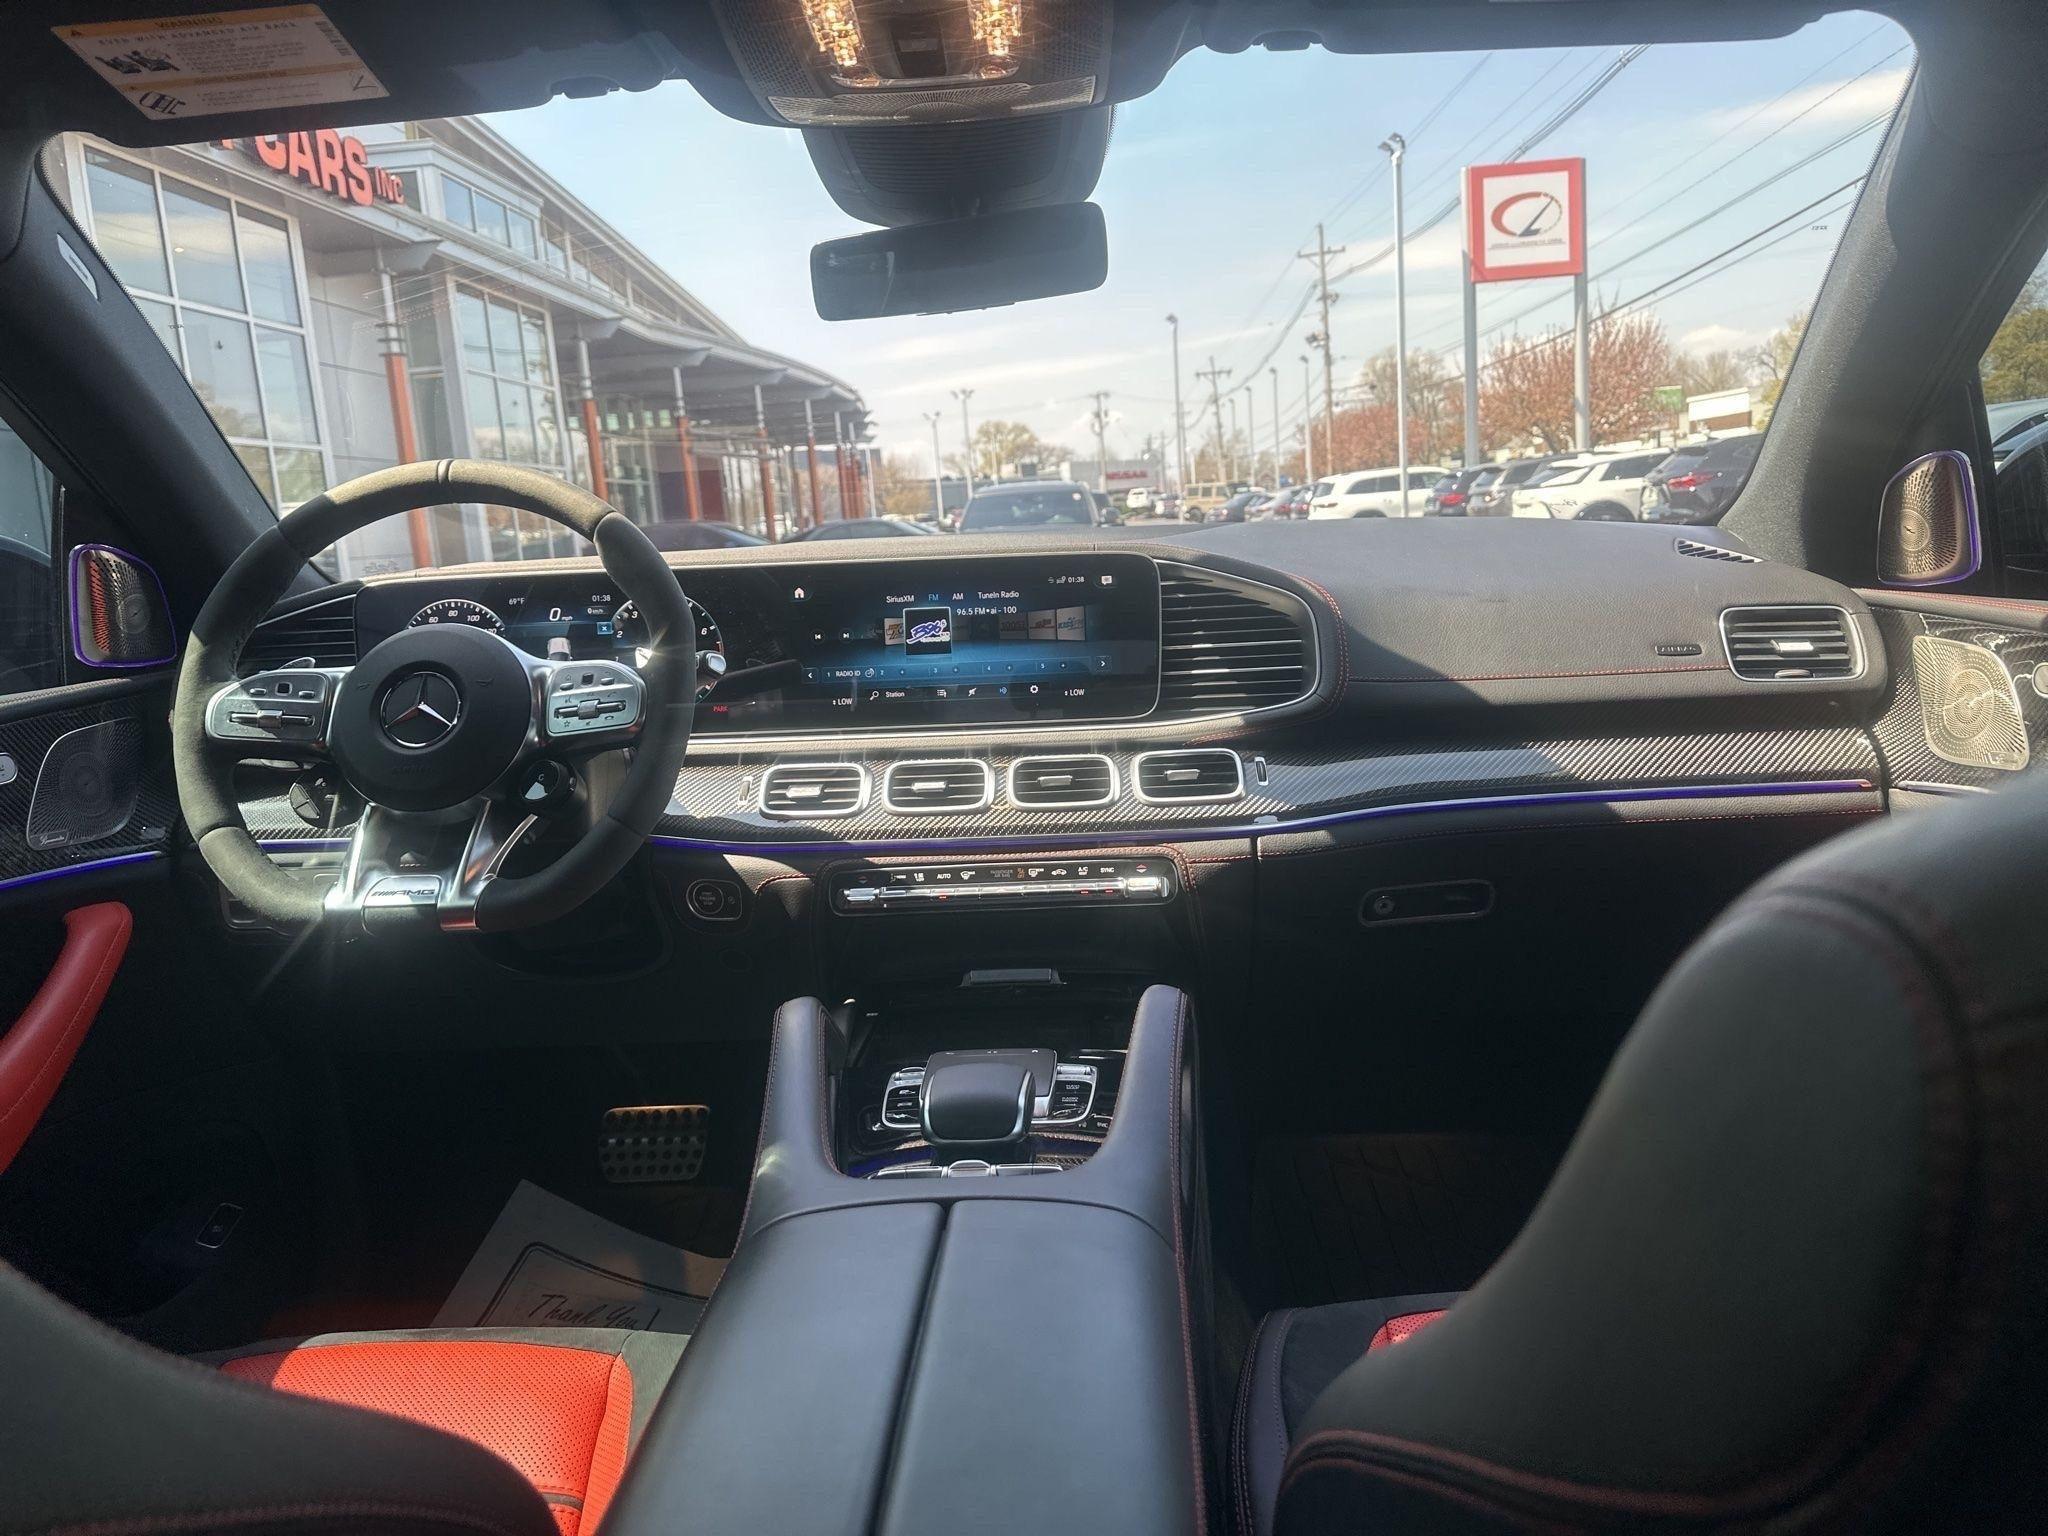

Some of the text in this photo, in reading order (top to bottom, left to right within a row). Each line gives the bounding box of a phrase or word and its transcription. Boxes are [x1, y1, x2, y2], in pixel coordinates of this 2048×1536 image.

[255, 129, 405, 206] CARS INC
[886, 595, 915, 603] SiriusXM
[977, 590, 1020, 600] TuneIn Radio
[549, 607, 561, 621] 0
[631, 611, 638, 619] 3
[956, 608, 973, 616] 96.5
[1003, 606, 1017, 614] 100
[1069, 688, 1085, 696] LOW
[837, 698, 853, 706] LOW
[528, 1294, 608, 1324] Thank
